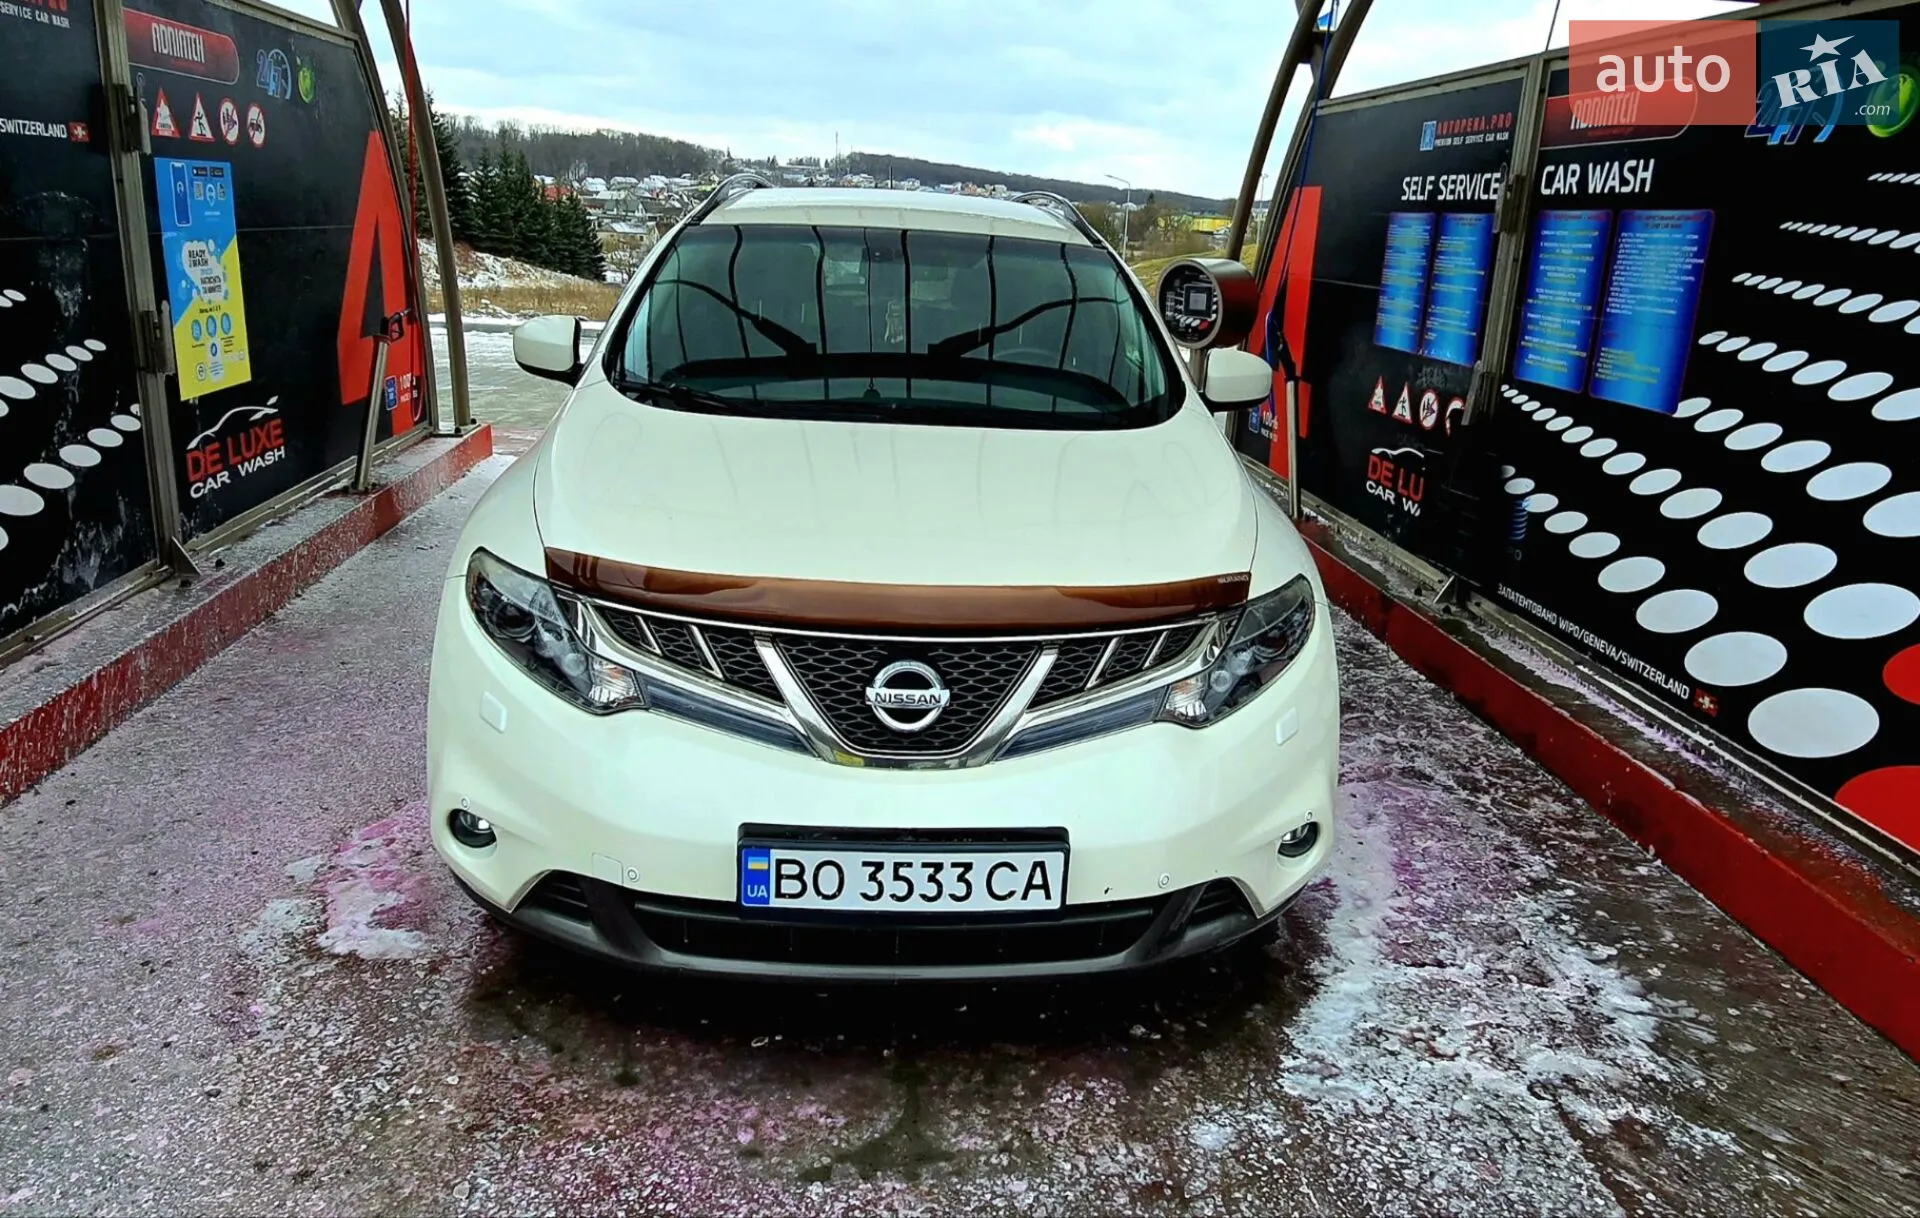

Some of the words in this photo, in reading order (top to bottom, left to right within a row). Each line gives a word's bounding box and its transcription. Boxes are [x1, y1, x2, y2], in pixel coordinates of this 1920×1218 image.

[35, 9, 49, 24] CAR
[0, 118, 68, 138] SWITZERLAND
[1401, 176, 1436, 201] SELF
[1437, 172, 1502, 201] SERVICE
[1540, 164, 1580, 195] CAR
[1588, 158, 1655, 194] WASH
[186, 442, 224, 483] DE
[227, 418, 284, 466] LUXE
[190, 470, 231, 499] CAR
[238, 446, 285, 477] WASH
[1367, 455, 1394, 488] DE
[1366, 480, 1395, 505] CAR
[874, 692, 942, 705] NISSAN
[747, 884, 767, 898] UA
[774, 858, 845, 901] BO
[859, 860, 974, 903] 3533
[985, 860, 1052, 901] CA
